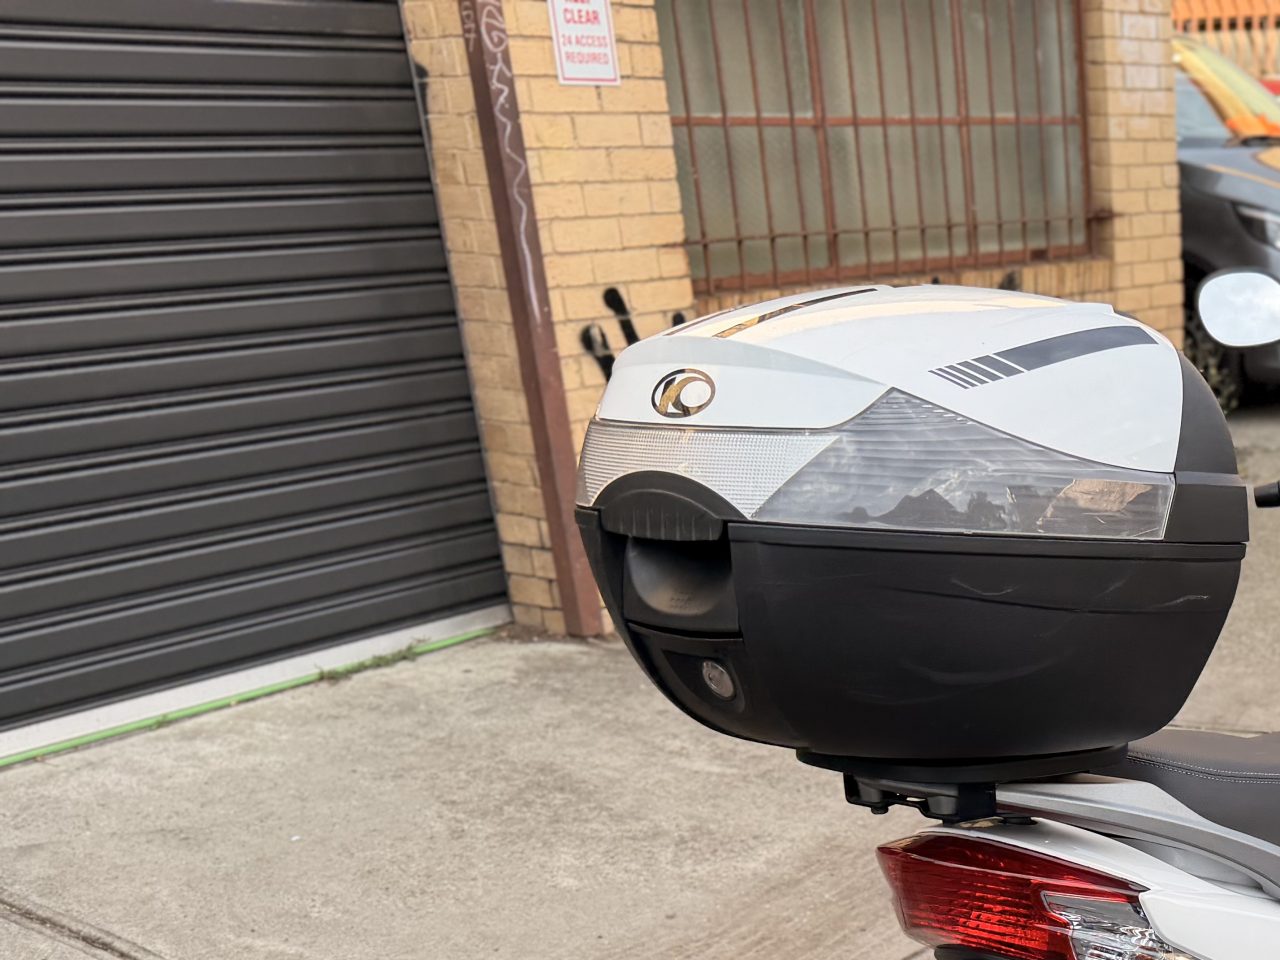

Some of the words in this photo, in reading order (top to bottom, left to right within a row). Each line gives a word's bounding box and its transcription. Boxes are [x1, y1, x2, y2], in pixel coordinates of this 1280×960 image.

[563, 8, 600, 25] CLEAR
[575, 34, 608, 48] ACCESS
[565, 51, 609, 64] REQUIRED
